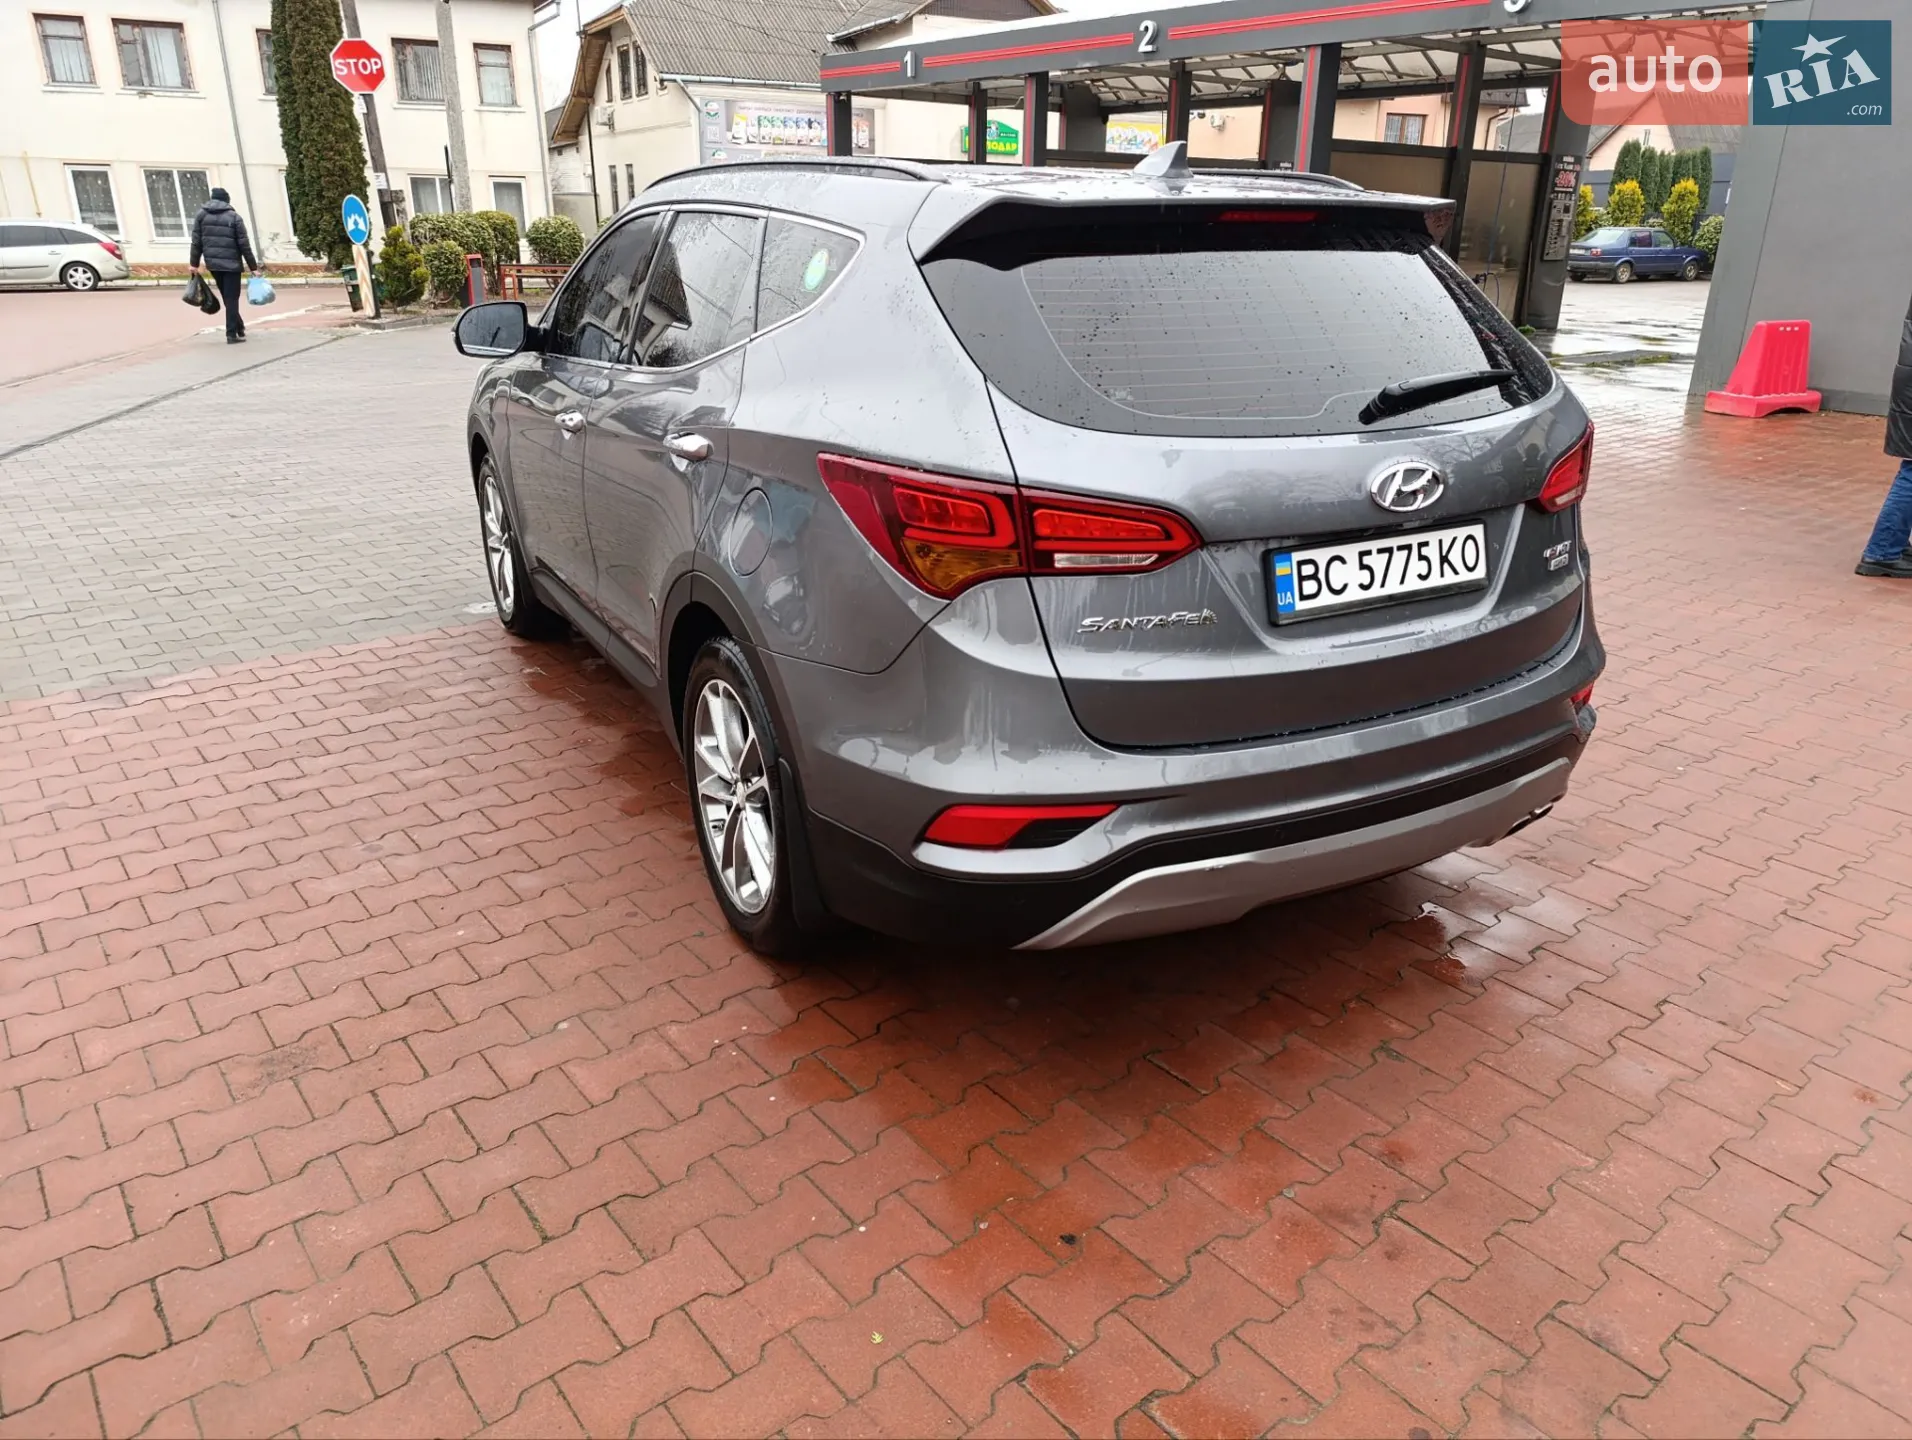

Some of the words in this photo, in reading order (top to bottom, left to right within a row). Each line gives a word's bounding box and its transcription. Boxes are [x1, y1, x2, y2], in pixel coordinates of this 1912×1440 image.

[1138, 20, 1156, 52] 2
[335, 58, 381, 75] STOP
[903, 51, 916, 78] 1
[1357, 540, 1432, 591] 5775
[1277, 592, 1294, 606] UA
